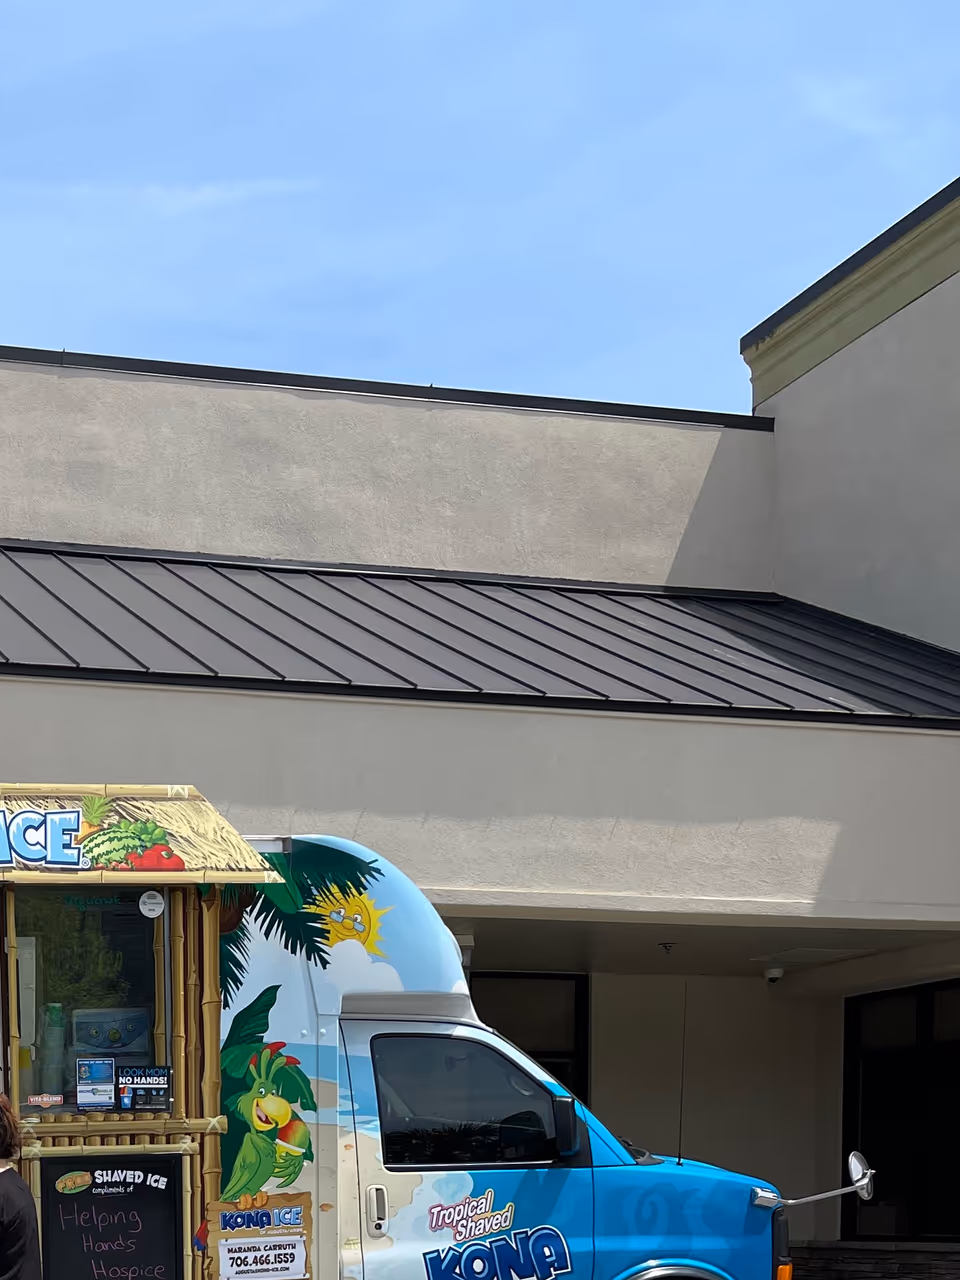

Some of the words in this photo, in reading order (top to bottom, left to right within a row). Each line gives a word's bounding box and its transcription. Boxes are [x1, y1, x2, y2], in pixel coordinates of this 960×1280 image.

[94, 1170, 144, 1184] SHAVED
[146, 1173, 168, 1189] ICE
[92, 1186, 124, 1195] compliments
[59, 1202, 142, 1232] Helping
[220, 1210, 271, 1232] KONA
[273, 1206, 303, 1227] ICE
[430, 1191, 492, 1228] Tropical
[455, 1205, 513, 1240] Shaved
[82, 1233, 137, 1252] Hands
[264, 1243, 296, 1251] CARRUTH
[229, 1253, 295, 1267] 706.466.1559
